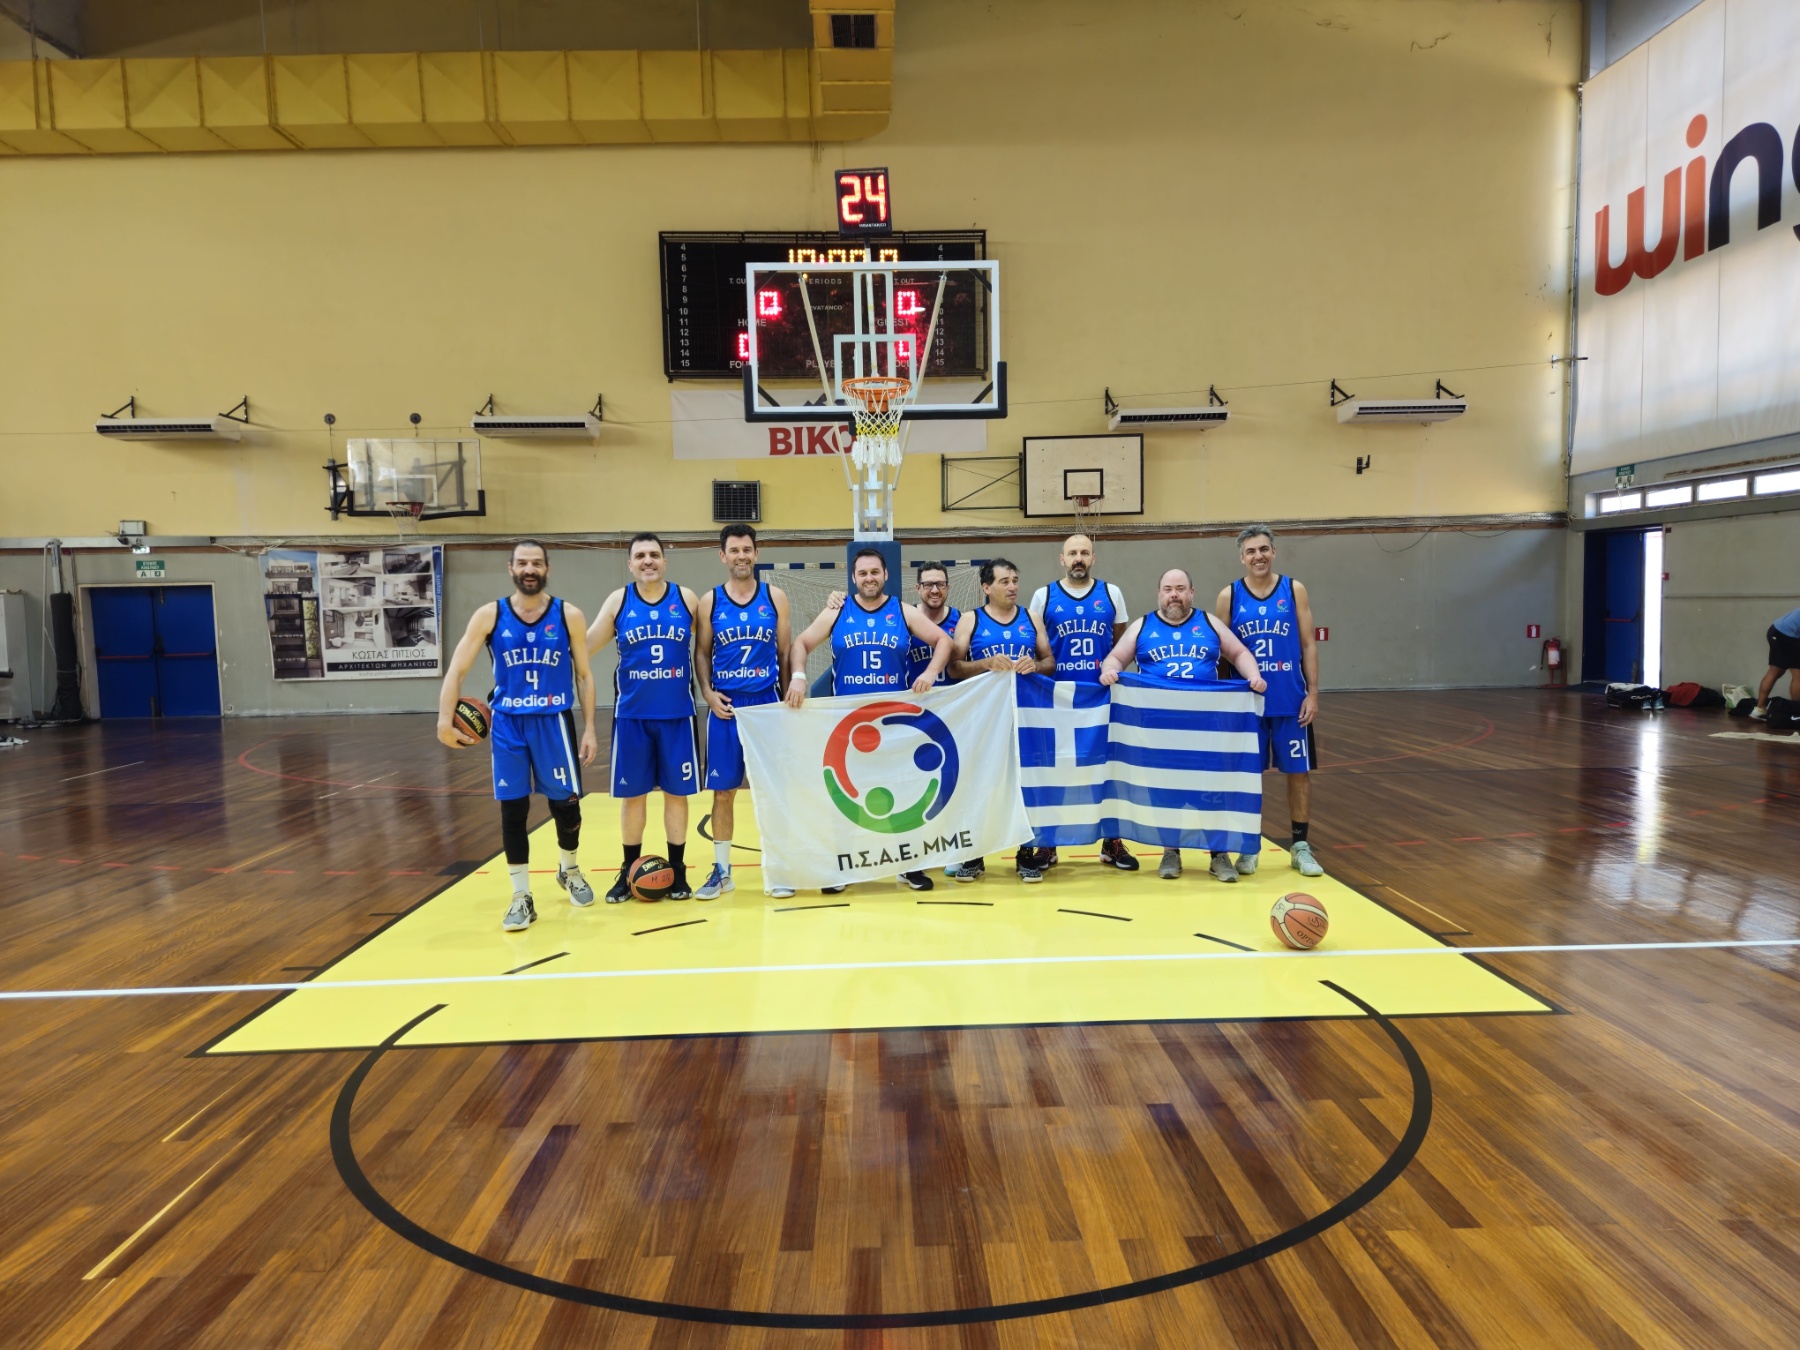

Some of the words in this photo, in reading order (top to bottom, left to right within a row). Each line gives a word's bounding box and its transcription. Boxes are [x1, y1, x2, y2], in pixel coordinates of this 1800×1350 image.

[840, 174, 887, 223] 24
[680, 243, 686, 251] 4
[937, 244, 944, 252] 4
[681, 253, 687, 261] 5
[681, 264, 687, 272] 6
[681, 275, 687, 283] 7
[682, 285, 688, 293] 8
[935, 338, 945, 346] 13
[680, 349, 690, 357] 14
[935, 348, 945, 356] 14
[680, 359, 690, 367] 15
[625, 624, 686, 645] HELLAS
[717, 626, 773, 646] HELLAS
[1055, 619, 1107, 637] HELLAS
[1238, 619, 1290, 637] HELLAS
[844, 631, 899, 649] HELLAS
[1070, 637, 1094, 657] 20
[1255, 638, 1273, 657] 21
[352, 650, 389, 659] ΚΩΣΤΑΣ
[391, 648, 426, 658] ΠΙΤΣΙΟΣ
[502, 648, 561, 667] HELLAS
[650, 645, 664, 664] 9
[740, 645, 752, 664] 7
[862, 650, 882, 670] 15
[1148, 643, 1209, 661] HELLAS
[338, 662, 387, 670] ΑΡΧΙΤΕΚΤΩΝ
[629, 666, 684, 680] mediatel
[717, 666, 770, 680] mediatel
[1056, 659, 1103, 672] mediat
[1166, 661, 1194, 679] 22
[526, 670, 539, 690] 4
[844, 672, 899, 685] mediatel
[502, 693, 566, 708] mediatel
[1288, 739, 1307, 758] 21
[553, 767, 567, 785] 4
[681, 761, 693, 781] 9
[837, 843, 919, 871] Π.Σ.Α.Ε.
[923, 830, 973, 856] ΜΜΕ
